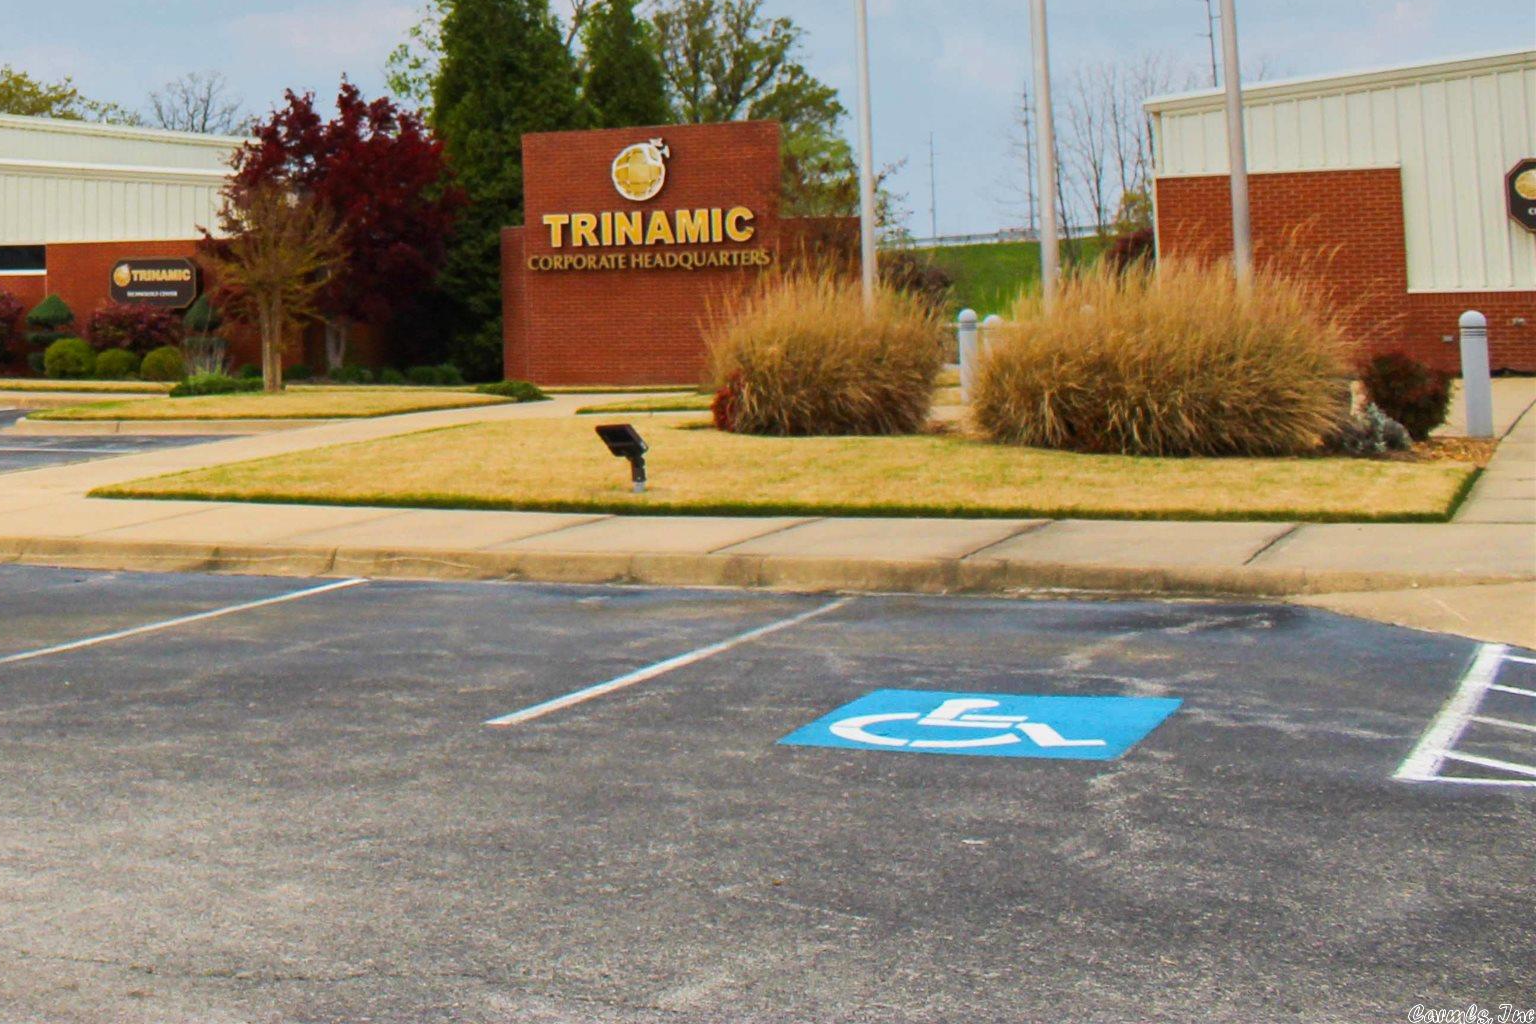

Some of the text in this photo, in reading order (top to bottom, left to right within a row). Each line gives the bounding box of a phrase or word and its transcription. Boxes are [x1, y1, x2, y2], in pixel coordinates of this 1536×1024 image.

[542, 206, 755, 248] TRINAMIC
[527, 248, 771, 271] CORPORATE HEADQUARTERS
[131, 268, 192, 282] TRINAMIC
